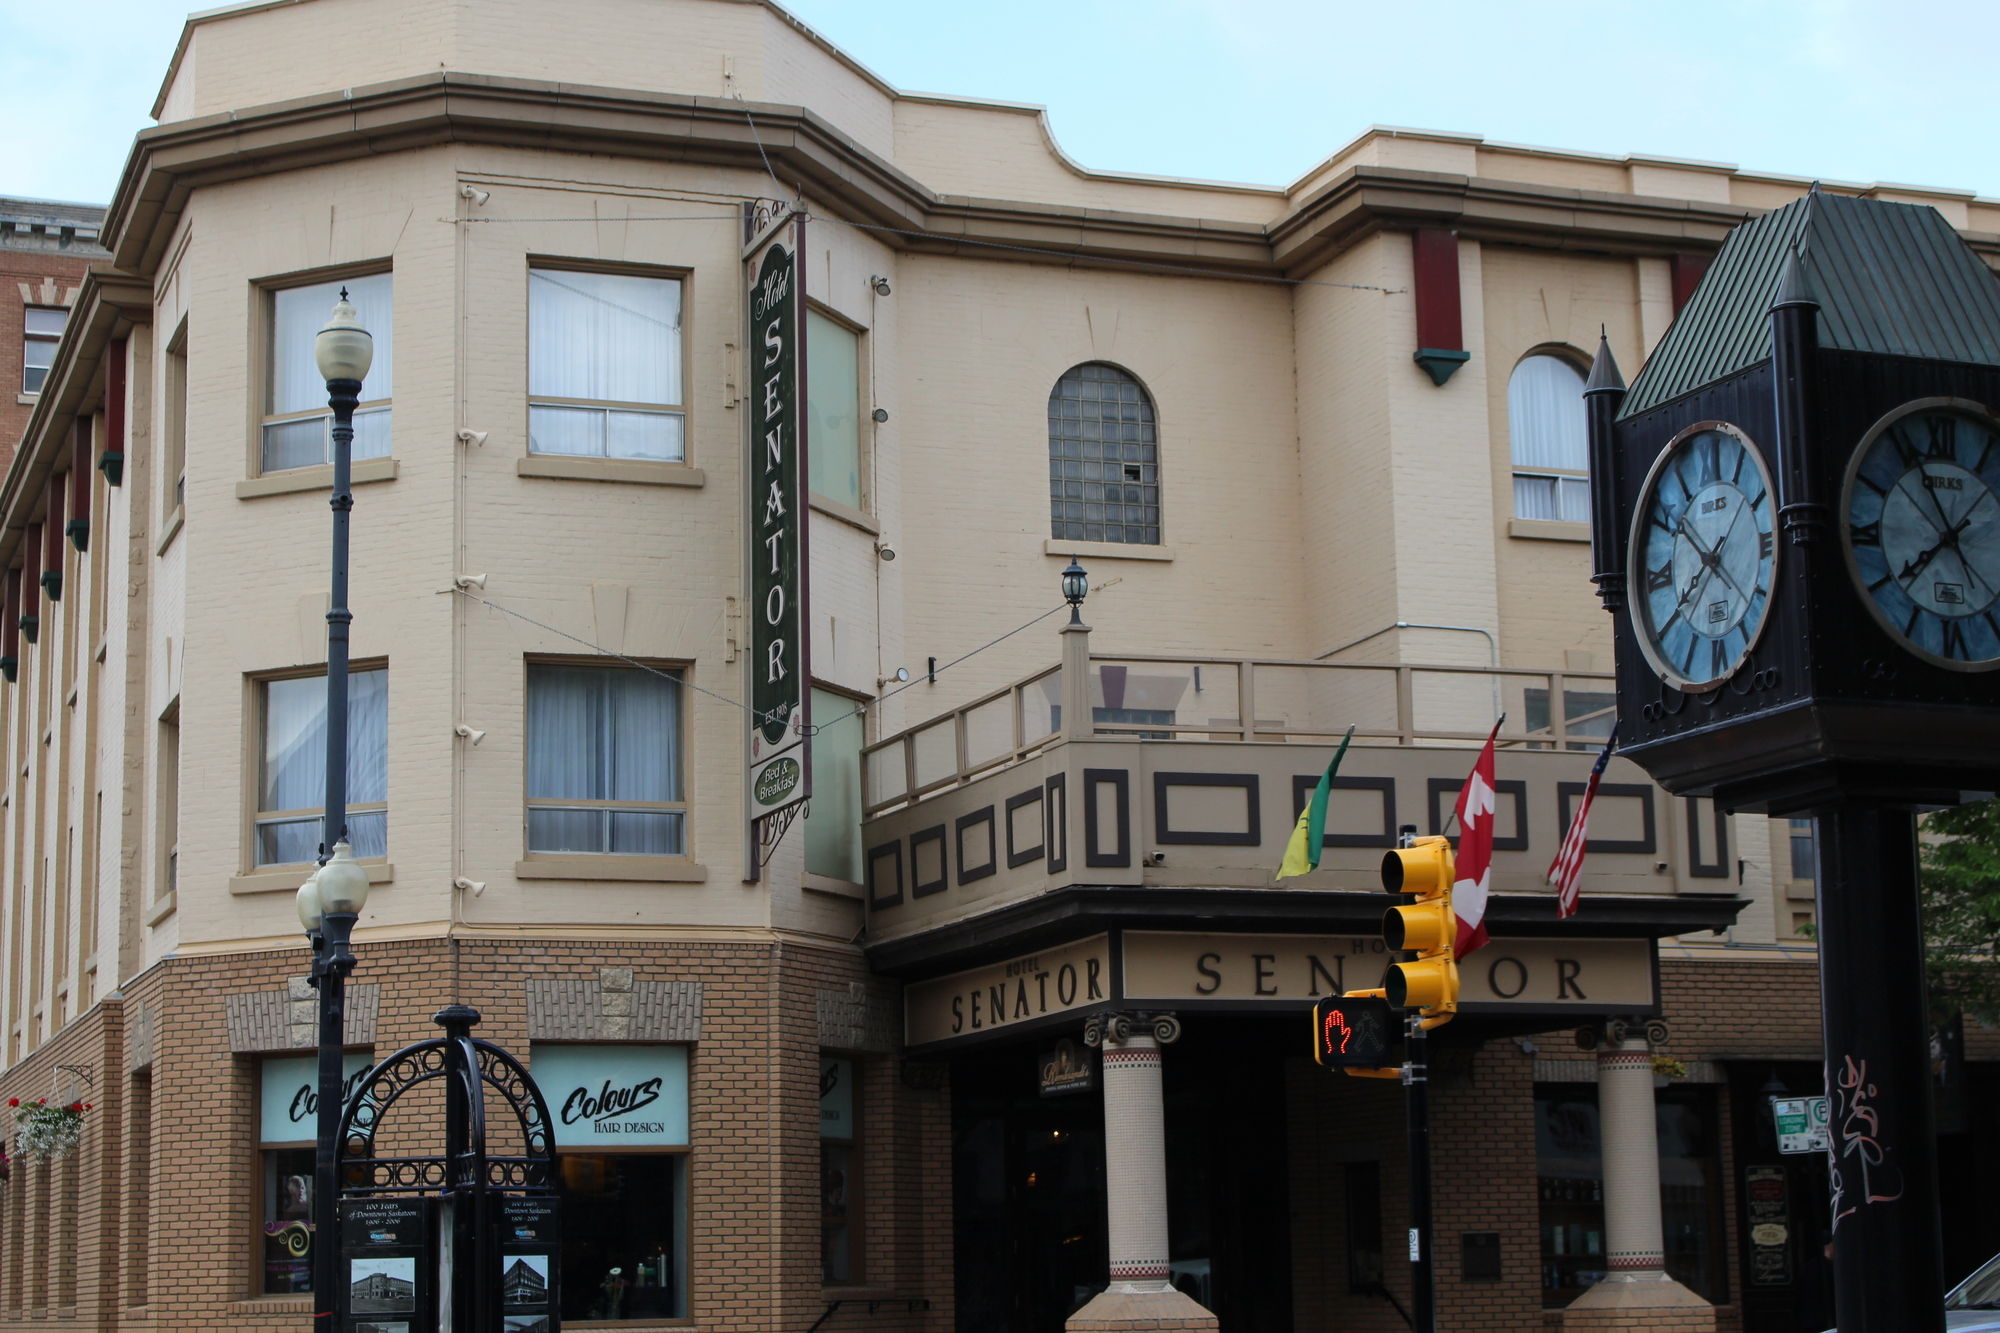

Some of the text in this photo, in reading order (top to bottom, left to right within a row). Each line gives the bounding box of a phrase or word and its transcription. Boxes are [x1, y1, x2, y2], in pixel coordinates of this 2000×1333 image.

[755, 265, 789, 321] Hotel
[763, 316, 789, 684] SENATOR
[760, 774, 795, 800] Breakfast
[765, 761, 788, 783] Bed &
[1005, 957, 1040, 978] HOTEL
[1196, 951, 1587, 1001] SENOR
[952, 958, 1103, 1034] SENATOR
[561, 1077, 663, 1125] Colours
[594, 1122, 665, 1134] HAIR DESIGN
[388, 1209, 417, 1217] Saskatoon
